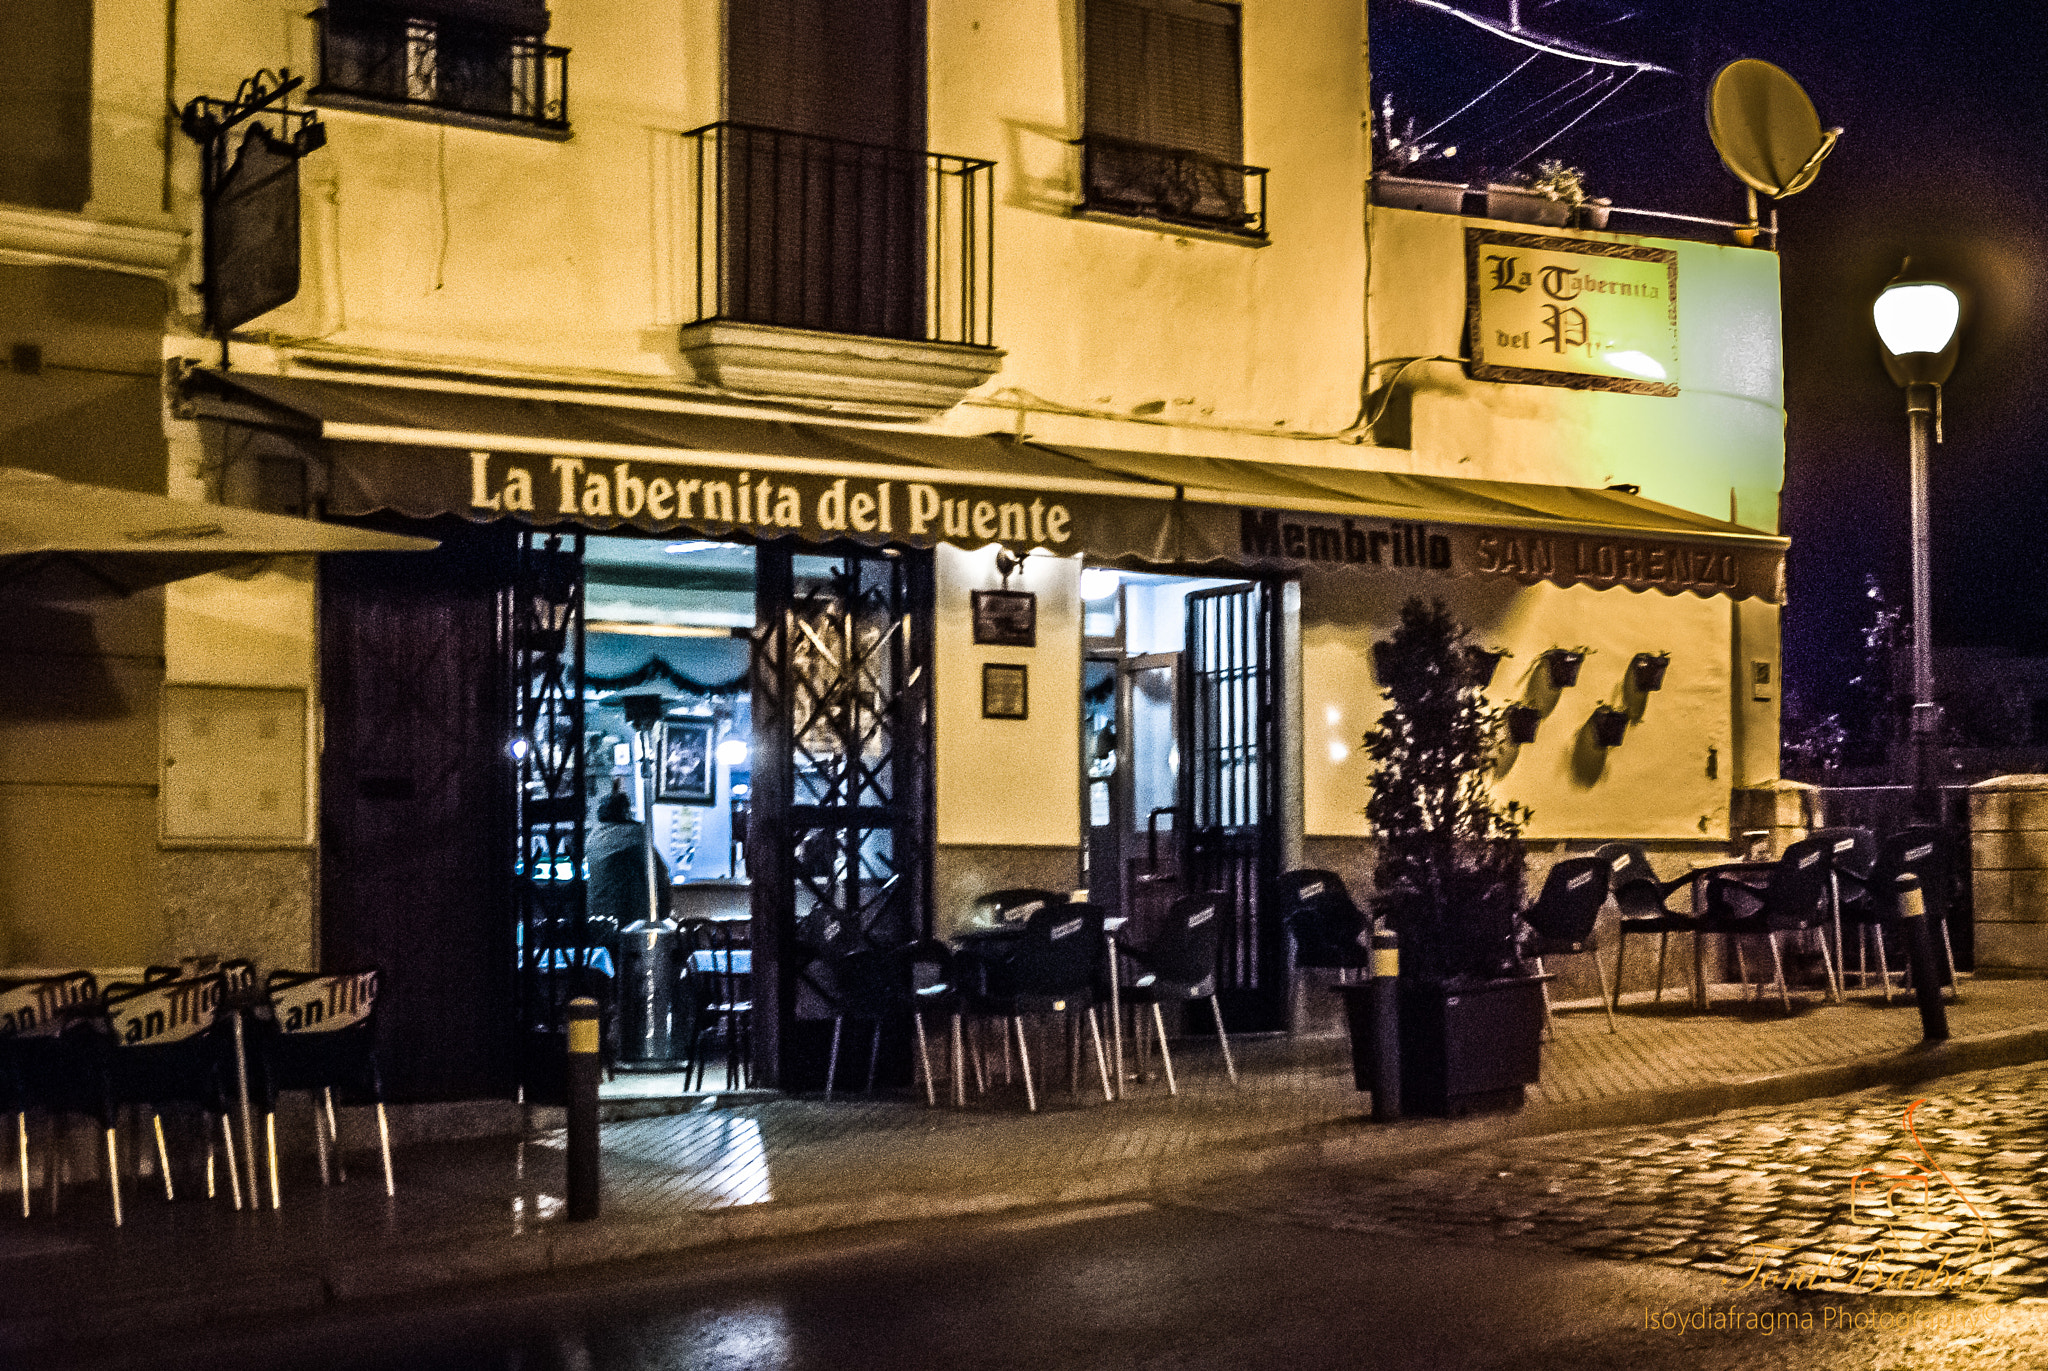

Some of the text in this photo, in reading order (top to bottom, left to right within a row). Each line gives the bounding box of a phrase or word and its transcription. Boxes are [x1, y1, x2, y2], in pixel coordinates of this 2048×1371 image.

[1486, 255, 1660, 301] La Tabernita
[469, 452, 1072, 543] La Tabernita del Puente
[1240, 509, 1739, 589] Membrillo SAN LORENZO
